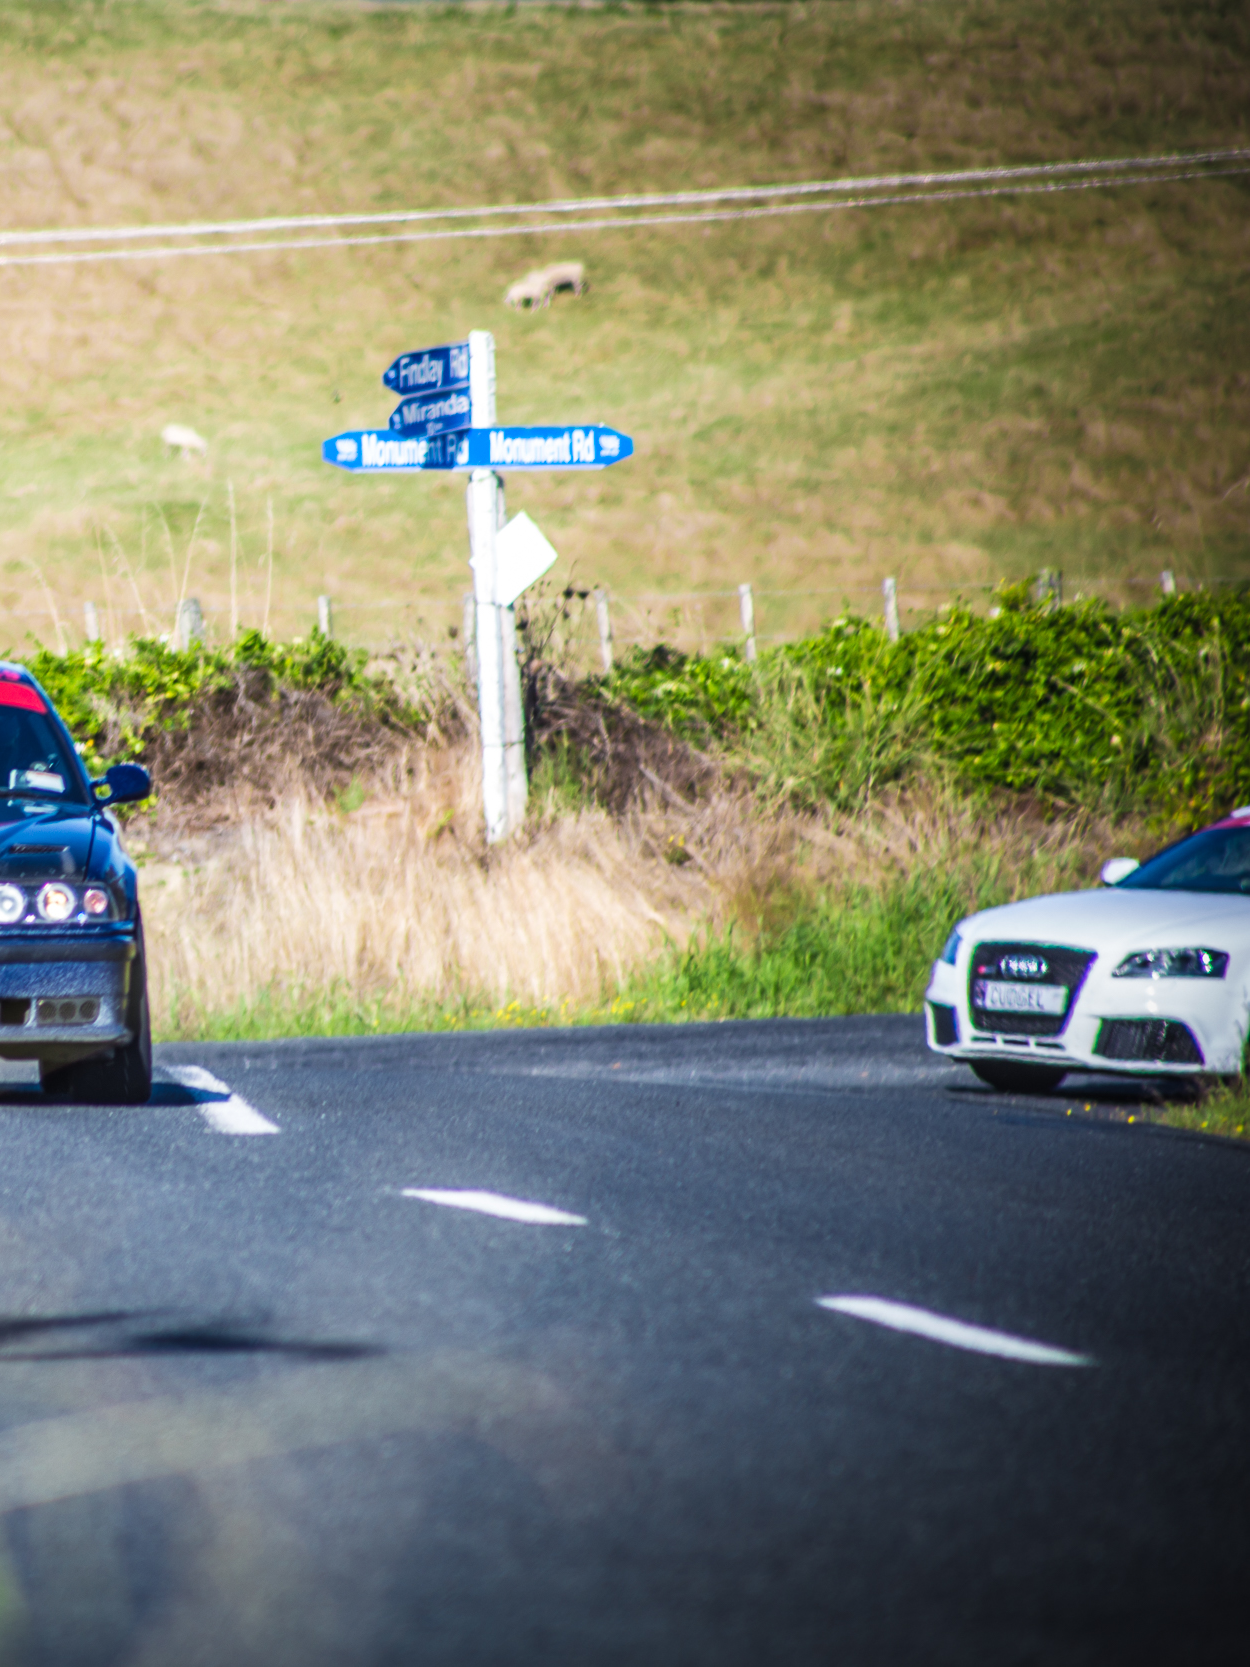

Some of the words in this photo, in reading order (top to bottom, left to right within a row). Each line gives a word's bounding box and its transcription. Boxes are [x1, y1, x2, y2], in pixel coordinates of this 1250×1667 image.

[449, 346, 468, 378] Rd
[402, 392, 469, 425] Miranda
[361, 433, 443, 467] Monument
[447, 432, 469, 465] Rd
[489, 430, 571, 464] Monument
[572, 429, 595, 463] Rd
